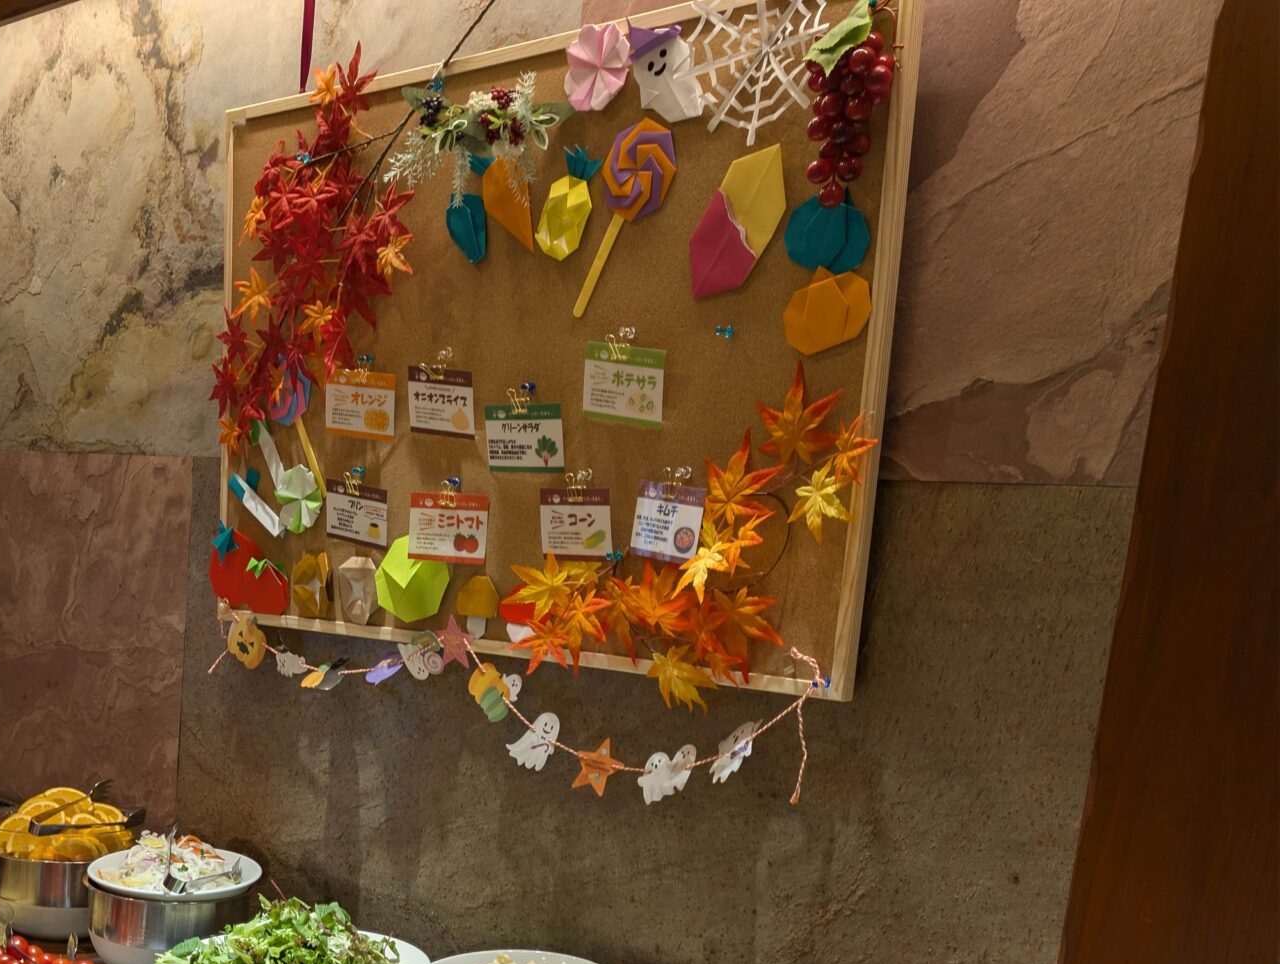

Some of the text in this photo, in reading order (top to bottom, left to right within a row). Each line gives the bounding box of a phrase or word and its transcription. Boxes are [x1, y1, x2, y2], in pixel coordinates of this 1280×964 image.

[350, 391, 388, 408] オレンジ
[413, 390, 468, 408] オニオンスライス
[501, 422, 542, 434] グリーンサラダ
[656, 502, 679, 518] キムチ
[438, 513, 484, 531] ミニトマト
[567, 512, 596, 528] コーン
